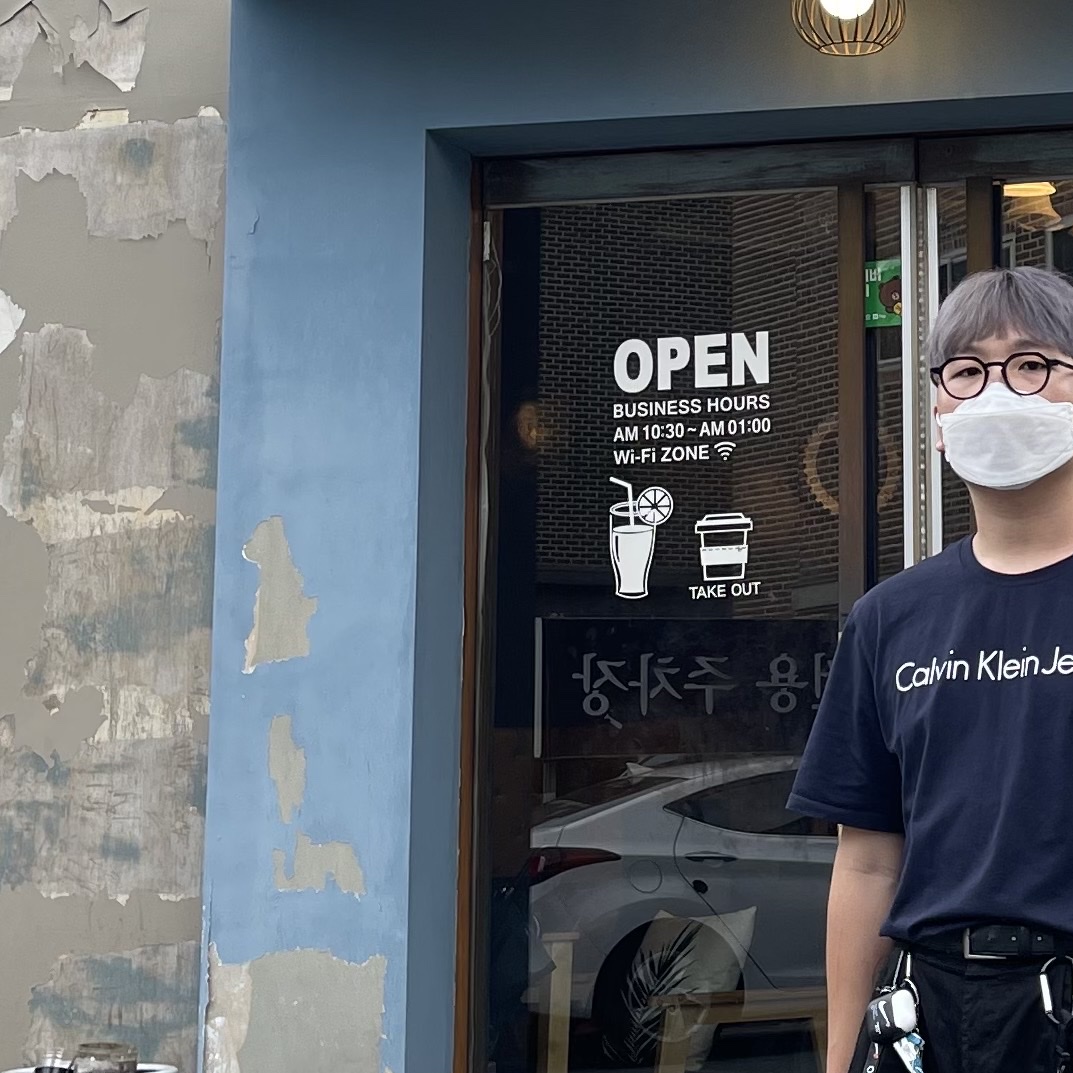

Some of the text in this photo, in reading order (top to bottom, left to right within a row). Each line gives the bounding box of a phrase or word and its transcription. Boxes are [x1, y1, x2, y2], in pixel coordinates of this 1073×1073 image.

[613, 331, 770, 393] OPEN
[613, 394, 771, 419] BUSINESS HOURS
[613, 425, 639, 442] AM
[643, 422, 685, 440] 10:30
[699, 420, 725, 437] AM
[728, 417, 771, 435] 01:00
[613, 444, 710, 465] Wi-Fi ZONE
[688, 581, 762, 600] TAKE OUT
[895, 650, 970, 692] Calvin
[977, 646, 1040, 681] Klein
